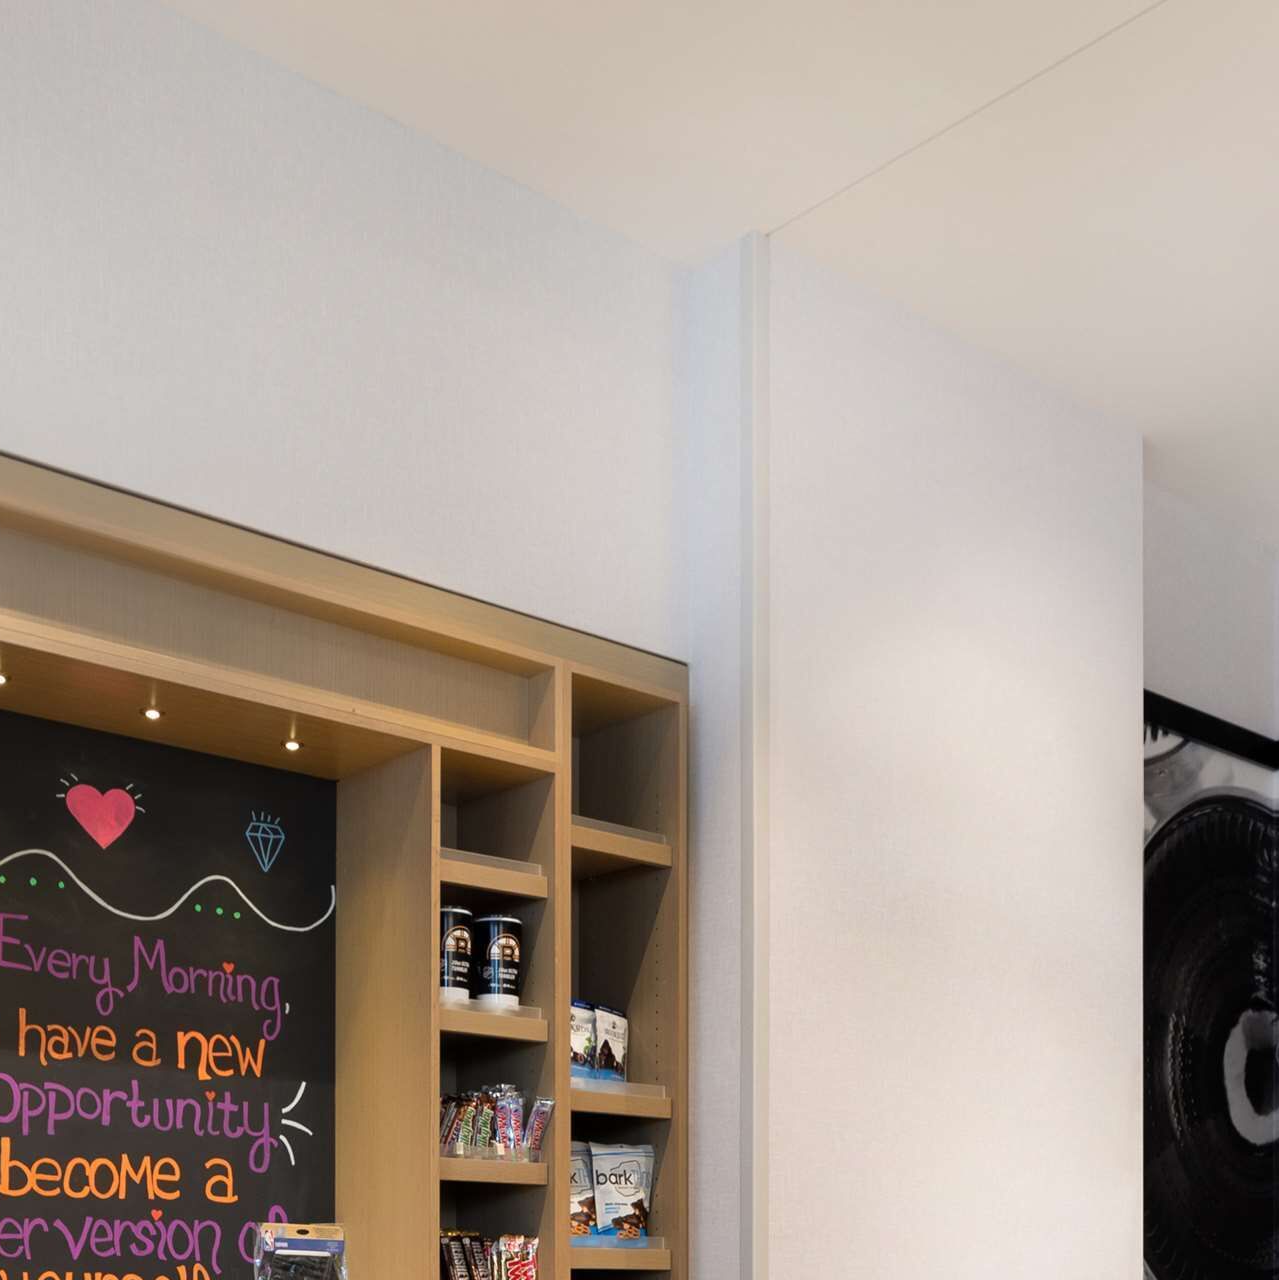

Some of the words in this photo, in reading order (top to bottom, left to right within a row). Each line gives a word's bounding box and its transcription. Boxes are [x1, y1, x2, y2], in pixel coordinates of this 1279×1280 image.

[18, 1007, 117, 1067] have
[131, 1028, 162, 1068] a
[176, 1029, 267, 1081] new
[204, 1157, 238, 1204] a
[595, 1169, 634, 1188] bark
[53, 1214, 222, 1275] version
